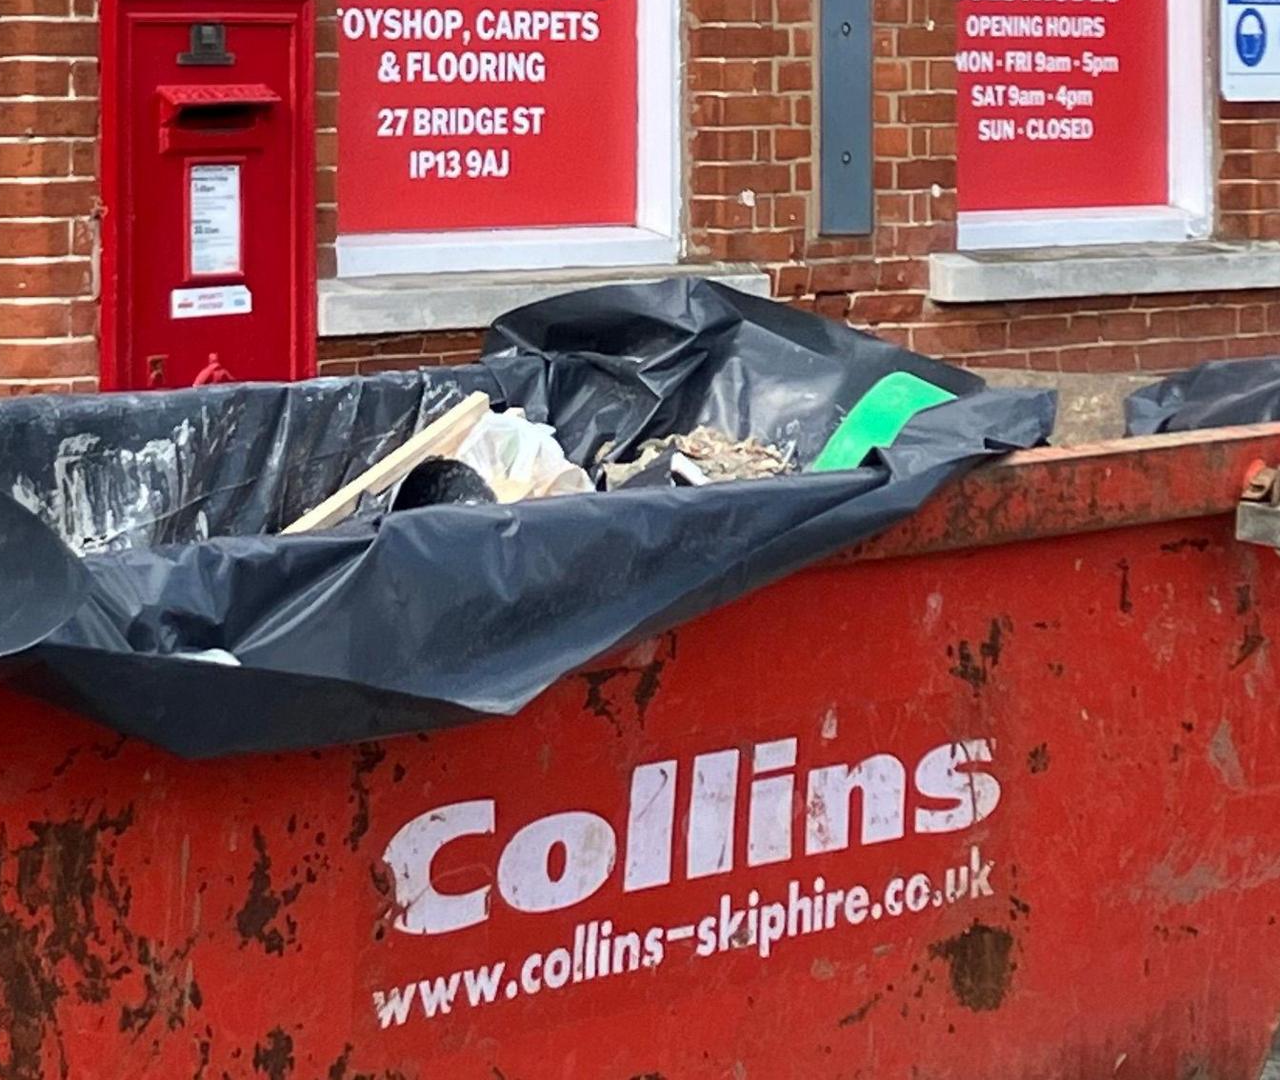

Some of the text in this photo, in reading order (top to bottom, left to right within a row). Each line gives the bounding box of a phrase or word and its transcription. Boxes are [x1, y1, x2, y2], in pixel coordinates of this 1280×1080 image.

[336, 8, 600, 45] OYSHOP, CARPETS
[966, 15, 1106, 38] OPENING HOURS
[378, 51, 546, 83] & FLOORING
[1005, 51, 1032, 73] FRI
[1035, 52, 1072, 73] 9am
[1082, 52, 1119, 76] 5pm
[971, 85, 1007, 107] SAT
[1008, 86, 1045, 107] 9am
[1055, 86, 1094, 110] 4pm
[377, 107, 545, 137] 27 BRIDGE ST
[978, 119, 1015, 141] SUN
[1026, 119, 1094, 141] CLOSED
[409, 149, 511, 179] IP13 9AJ
[382, 736, 1002, 937] Collins
[373, 846, 995, 1030] www.collins-skiphire.co.uk
